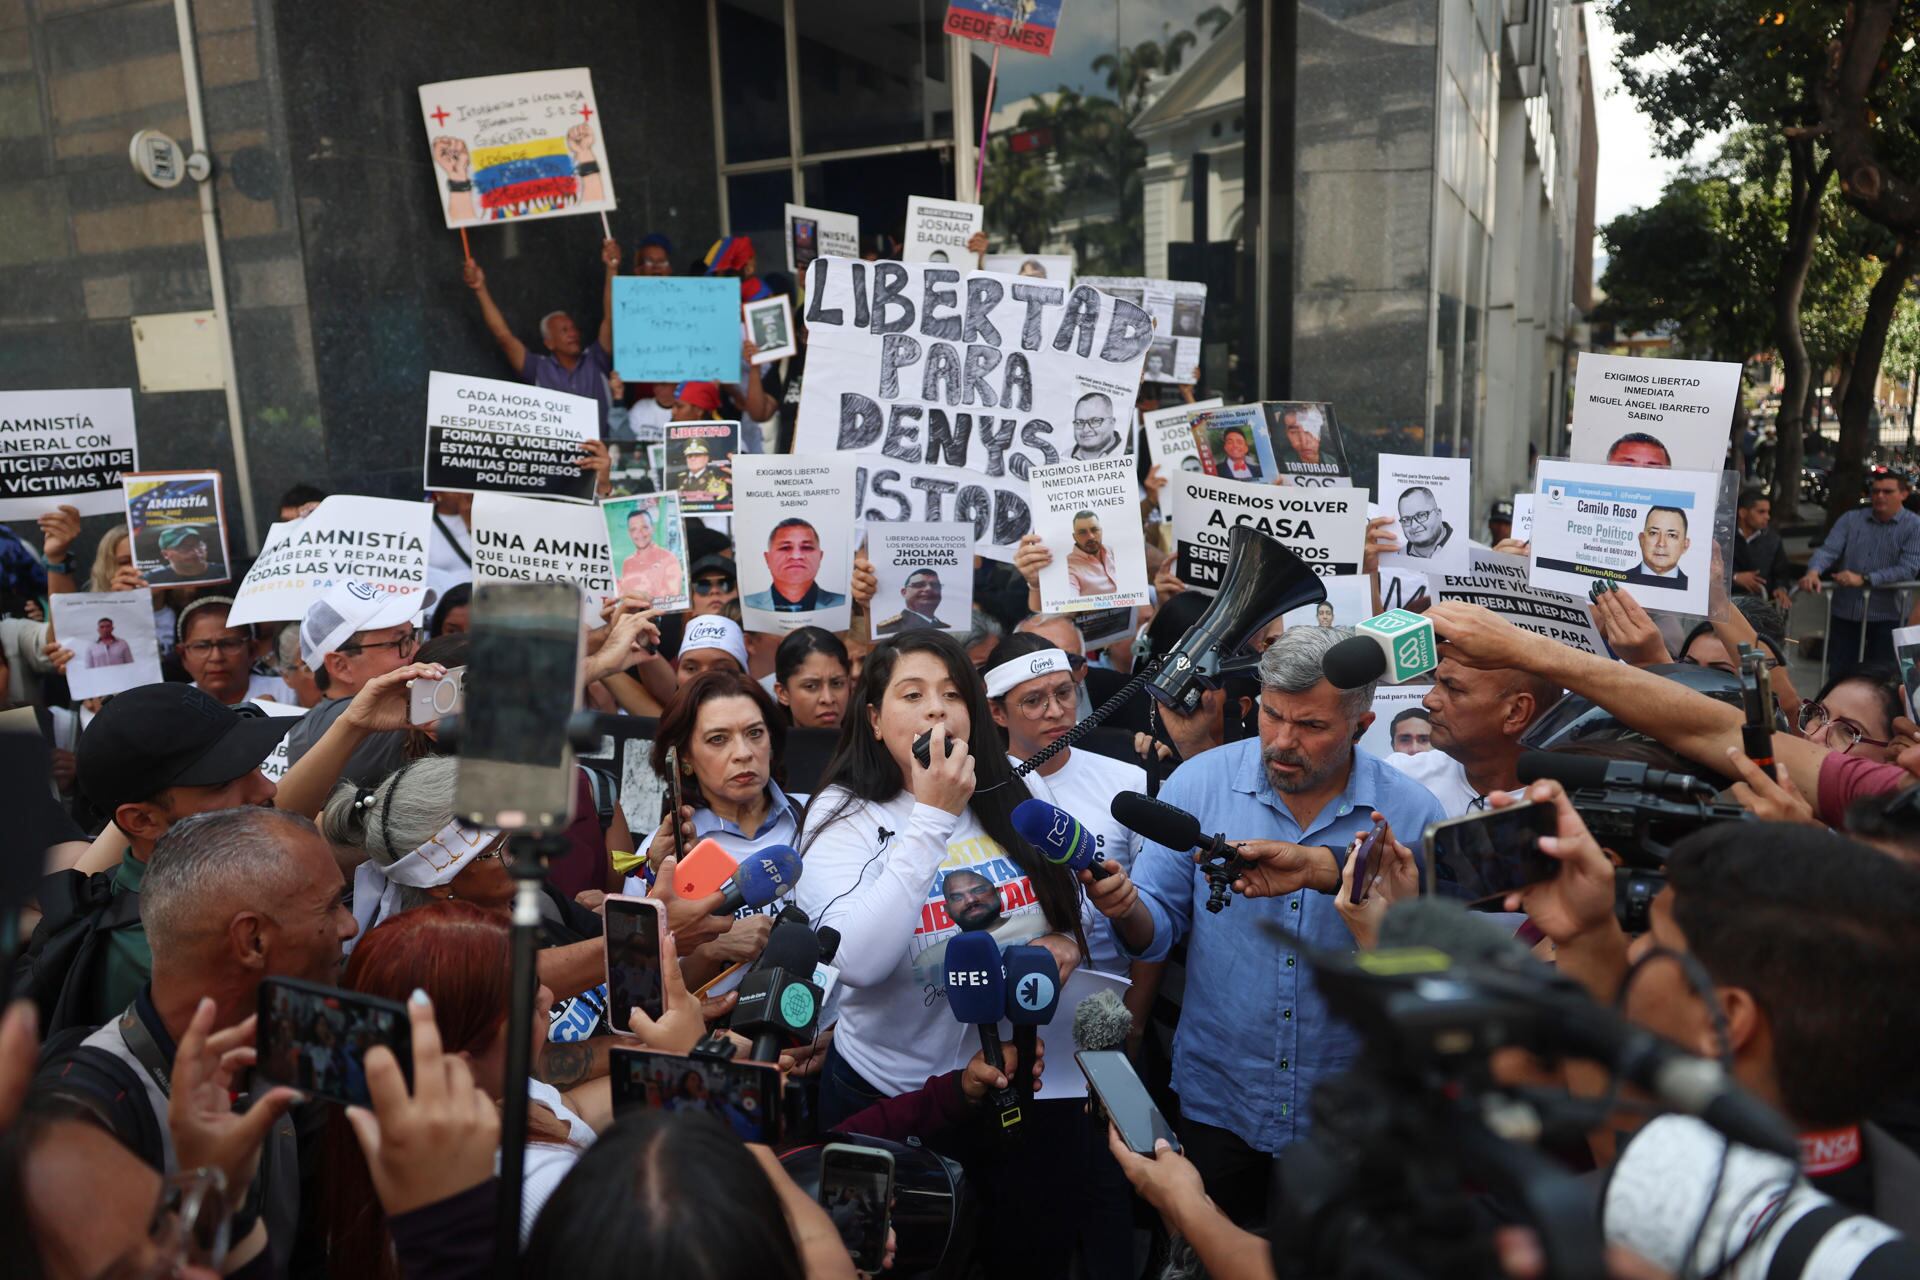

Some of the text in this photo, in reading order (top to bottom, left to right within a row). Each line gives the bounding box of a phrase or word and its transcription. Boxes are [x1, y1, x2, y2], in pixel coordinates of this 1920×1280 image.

[917, 218, 970, 233] JOSNAR
[806, 258, 1154, 363] LIBERTAD
[879, 334, 1033, 412] PARA
[1604, 372, 1700, 387] EXIGIMOS LIBERTAD
[456, 388, 572, 414] CADA HORA QUE
[1624, 386, 1674, 398] INMEDIATA
[468, 404, 562, 424] PASAMOS SIN
[1589, 395, 1710, 414] MIGUEL ÁNGEL IBARRETO
[0, 413, 94, 432] AMNISTÍA
[1628, 411, 1663, 422] SABINO
[440, 415, 583, 440] RESPUESTAS ES UNA
[836, 392, 1060, 482] DENYS
[76, 435, 111, 448] CON
[441, 429, 588, 453] FORMA DE VIOLENCI
[109, 451, 131, 465] DE
[440, 442, 499, 458] ESTATAL
[502, 449, 557, 464] CONTRA
[441, 456, 581, 477] FAMILIAS DE PRESOS
[795, 467, 830, 475] LIBERTAD
[1032, 459, 1133, 479] EXIGIMOS LIBERTAD
[1285, 462, 1340, 473] TORTURADO
[5, 472, 100, 493] VÍCTIMAS,
[476, 472, 546, 487] POLÍTICOS
[1042, 471, 1125, 488] INMEDIATA PARA
[147, 495, 208, 510] AMNISTÍA
[746, 490, 775, 498] MIGUEL
[1047, 485, 1126, 502] VICTOR MIGUEL
[1186, 485, 1348, 514] QUEREMOS VOLVER
[1051, 497, 1125, 513] MARTIN YANES
[1577, 500, 1637, 519] Camilo Roso
[1207, 508, 1227, 529] A
[1567, 520, 1634, 541] Preso Político
[260, 529, 423, 560] UNA AMNISTÍA
[476, 529, 525, 552] UNA
[252, 549, 423, 574] QUE LIBERE Y REPARE A
[476, 549, 611, 574] QUE LIBERE Y REP
[893, 558, 958, 566] CARDENAS
[896, 549, 954, 558] JHOLMAR
[246, 560, 423, 584] TODAS LAS VÍCTIMAS
[476, 563, 531, 582] TODAS
[1190, 562, 1219, 582] EN
[1575, 565, 1627, 580] #LiberenARoso
[313, 578, 357, 588] PA
[1445, 575, 1507, 591] EXCLUYE
[1095, 592, 1144, 602] INJUSTAMENTE
[1467, 596, 1515, 611] LIBERA
[1519, 602, 1532, 613] NI
[1534, 604, 1588, 625] REPARA
[1550, 627, 1592, 646] PARA
[1418, 629, 1429, 668] NOTICIAS
[760, 858, 782, 884] AFP
